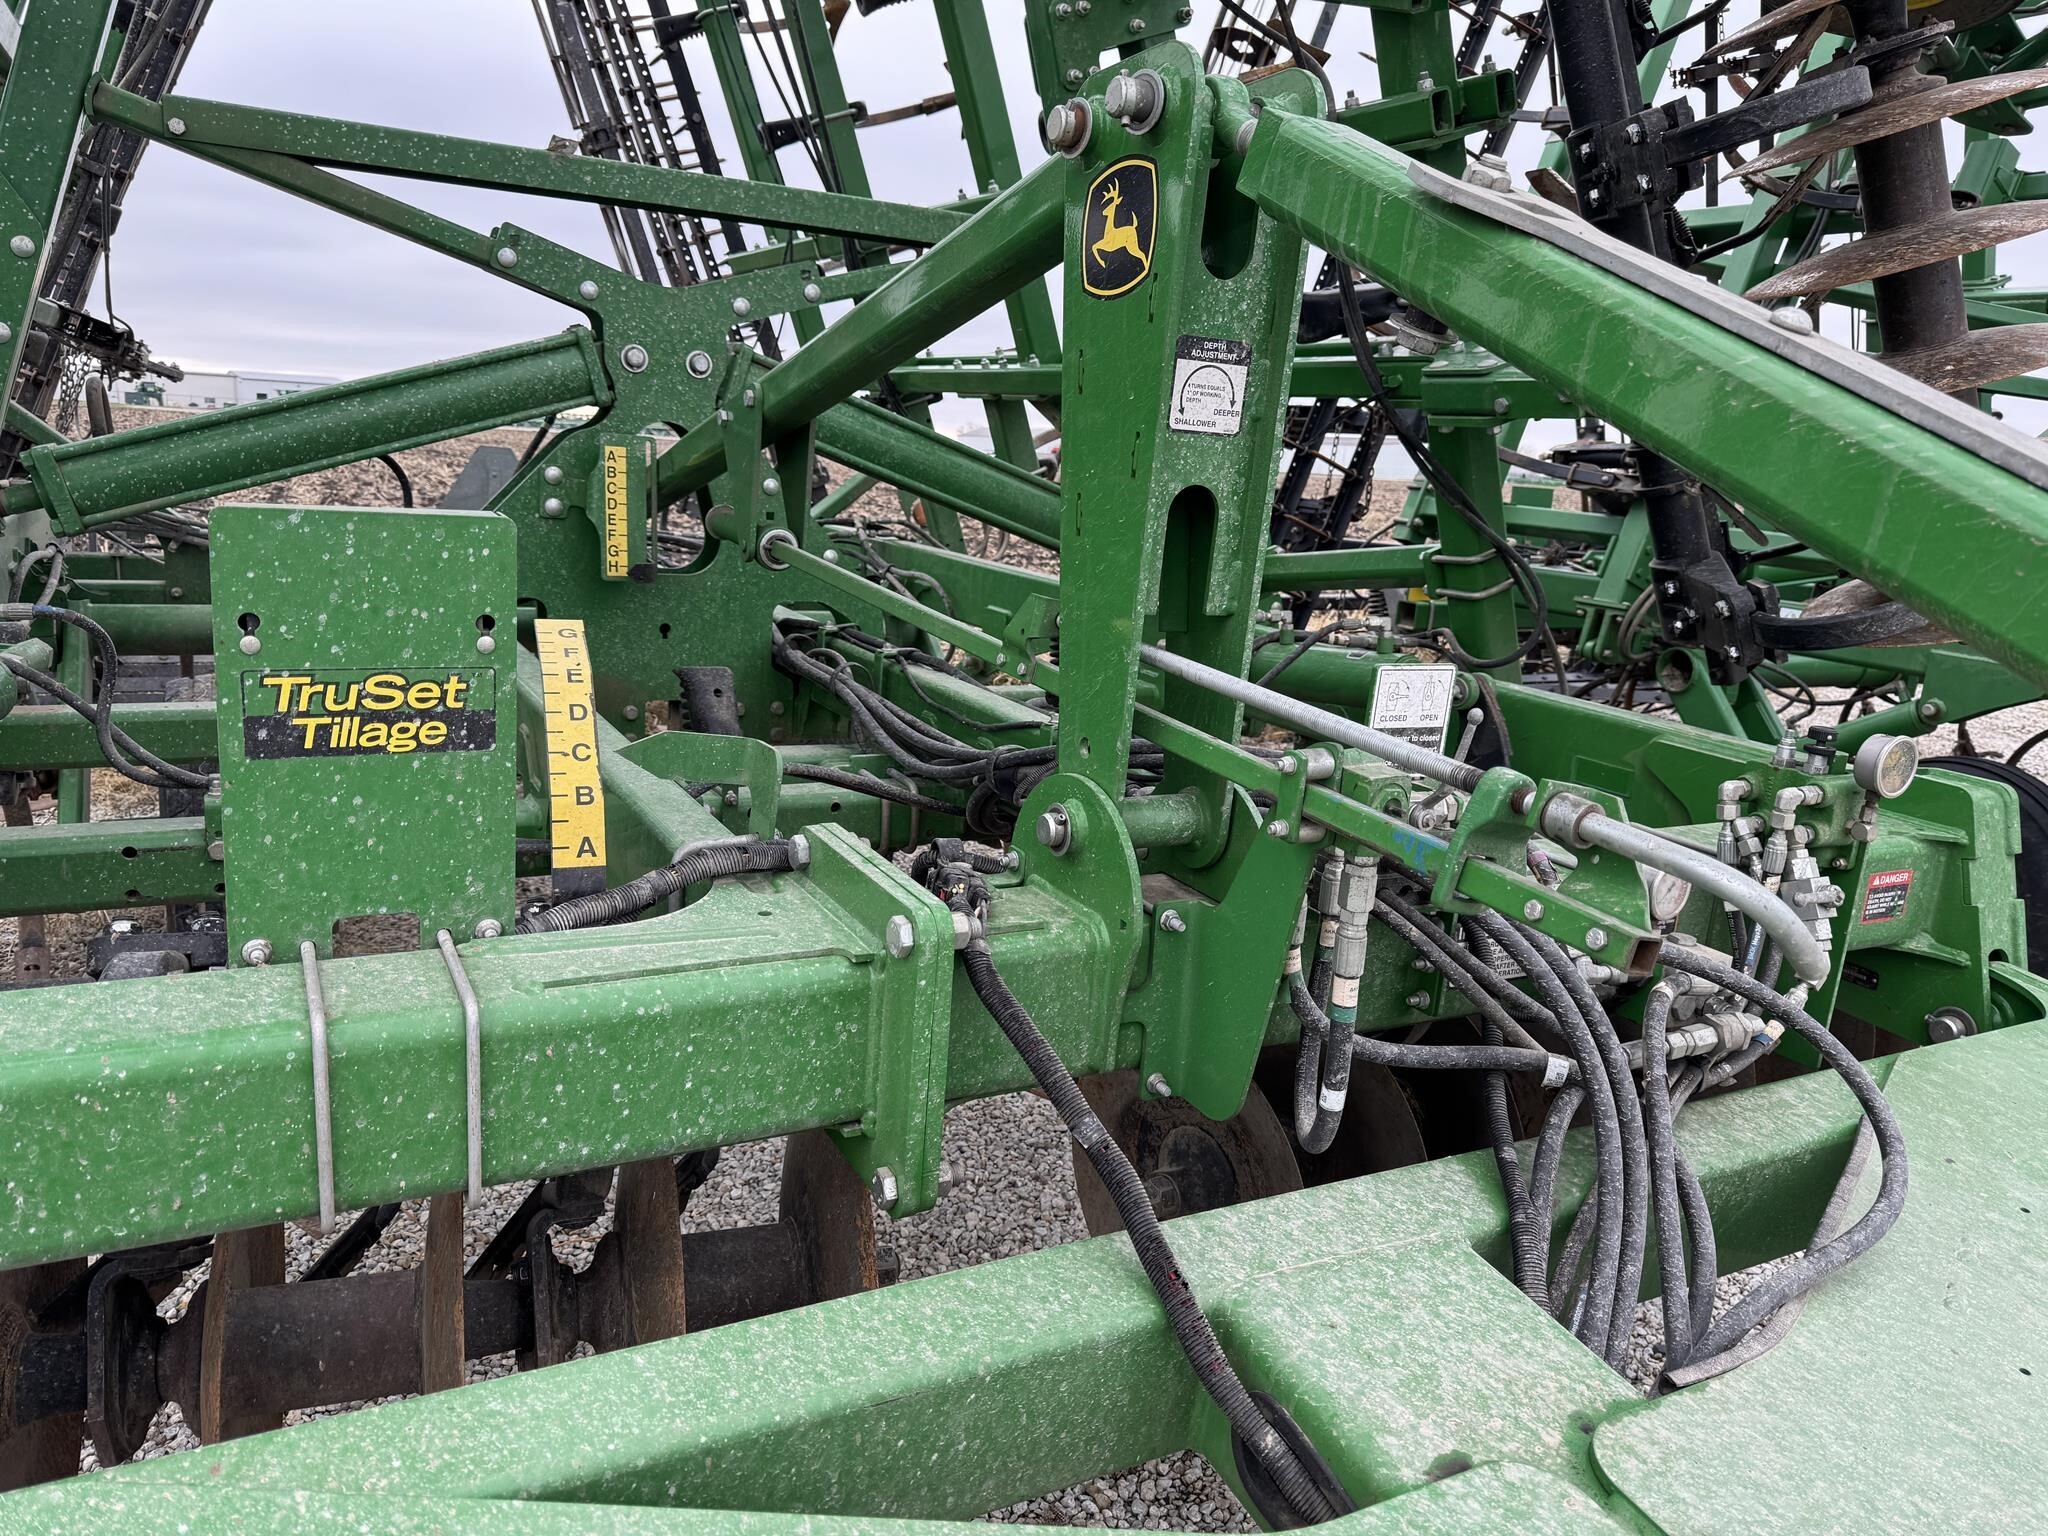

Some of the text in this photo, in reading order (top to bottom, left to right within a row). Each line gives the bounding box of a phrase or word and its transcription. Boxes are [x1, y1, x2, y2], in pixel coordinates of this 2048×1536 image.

[1204, 341, 1226, 350] DEPTH
[1191, 350, 1238, 361] ADJUSTMENT
[1213, 408, 1240, 417] DEEPER
[1174, 418, 1216, 428] SHALLOWER
[606, 450, 617, 463] A
[607, 466, 617, 478] B
[607, 482, 617, 495] C
[607, 498, 618, 510] D
[608, 514, 617, 526] E
[608, 529, 616, 542] F
[608, 544, 620, 558] G
[609, 560, 618, 573] H
[558, 628, 577, 638] G
[563, 647, 579, 658] F
[566, 668, 584, 683] E
[262, 674, 469, 713] TruSet
[568, 704, 588, 721] D
[1380, 714, 1408, 722] CLOSED
[291, 716, 448, 753] Tillage
[572, 743, 592, 761] C
[575, 786, 595, 806] B
[576, 836, 598, 858] A
[1880, 872, 1908, 884] DANGER
